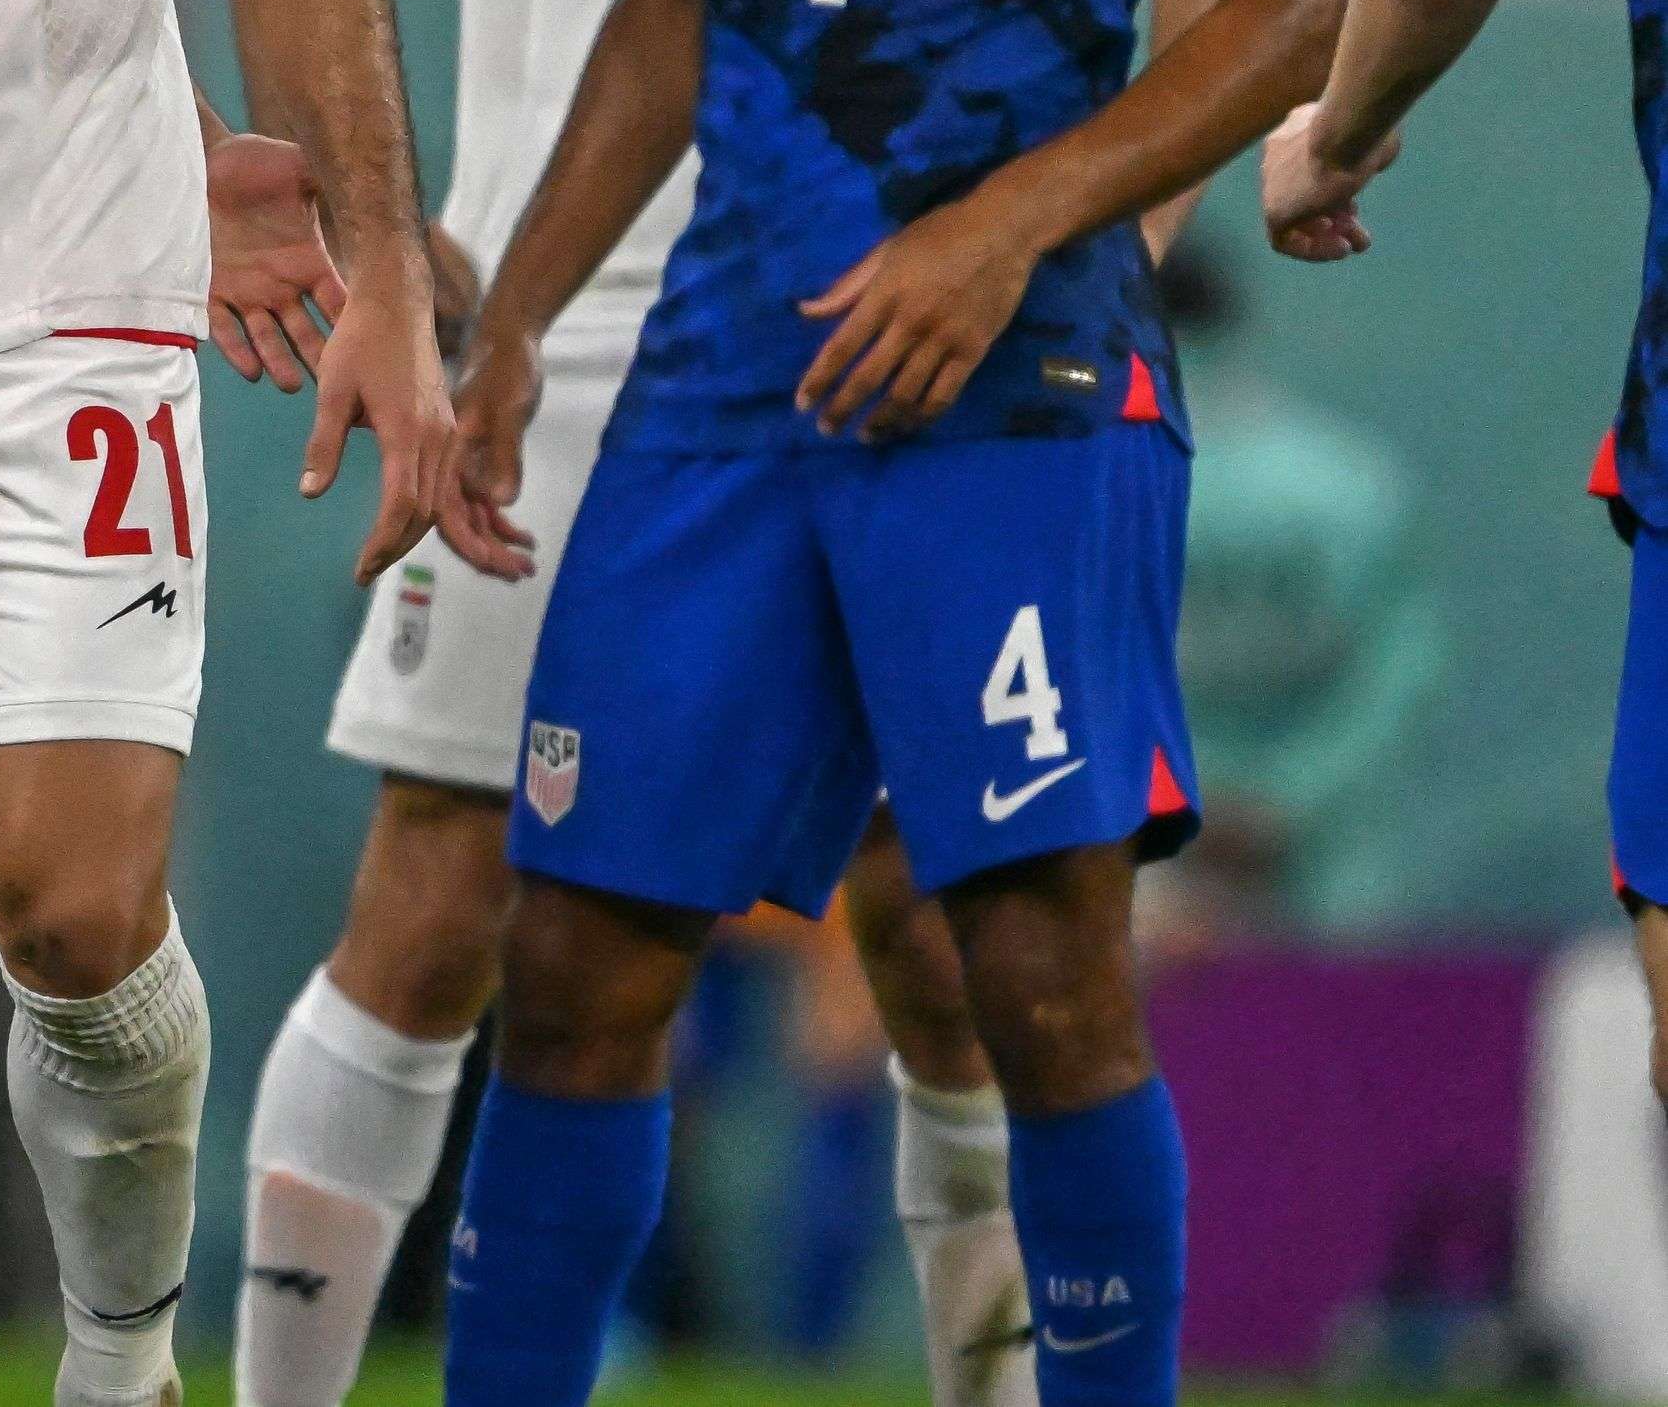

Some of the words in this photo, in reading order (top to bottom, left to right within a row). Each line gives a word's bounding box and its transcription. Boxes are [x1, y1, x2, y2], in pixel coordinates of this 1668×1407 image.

[66, 402, 194, 560] 21
[981, 604, 1068, 759] 4
[532, 729, 576, 766] USA
[1047, 1275, 1132, 1308] USA
